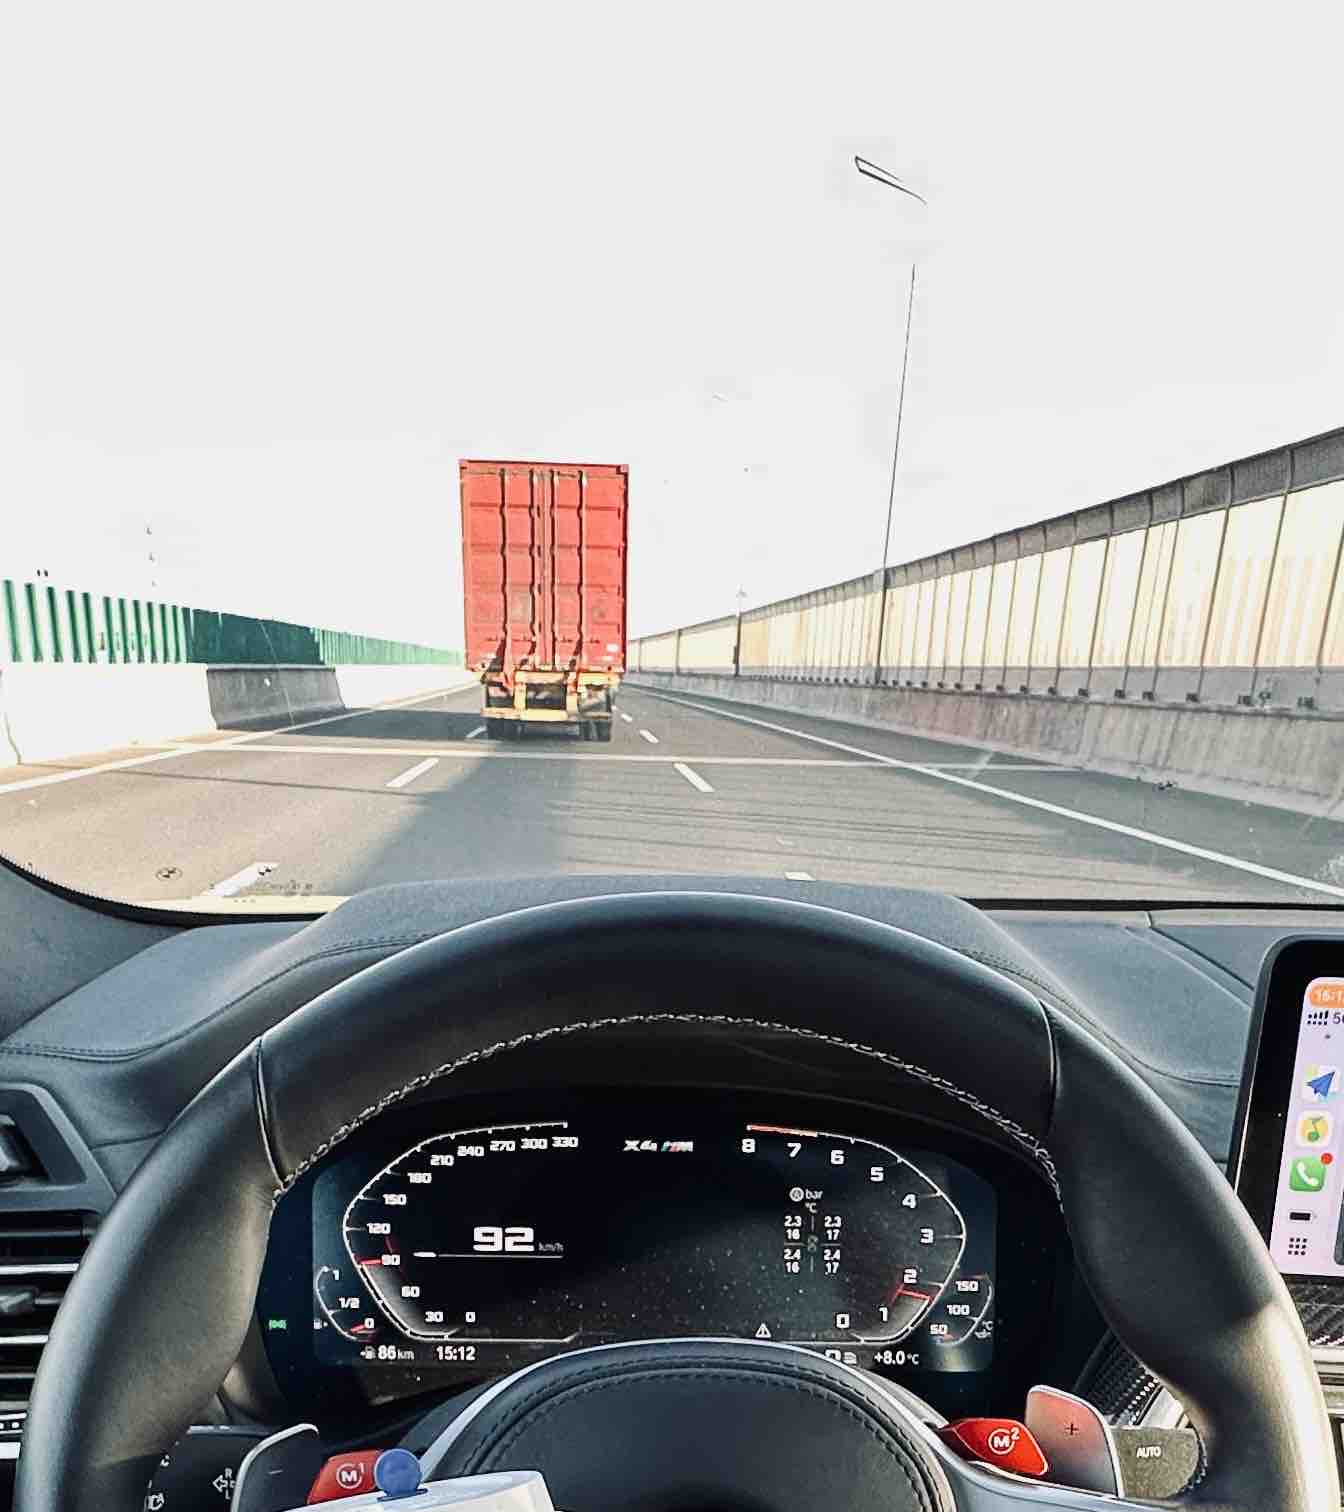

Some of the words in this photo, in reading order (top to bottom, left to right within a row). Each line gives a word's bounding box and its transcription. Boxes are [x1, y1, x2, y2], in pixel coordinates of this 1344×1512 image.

[490, 1140, 516, 1152] 270
[520, 1138, 548, 1150] 300
[552, 1136, 579, 1148] 330
[741, 1138, 756, 1153] 8
[457, 1145, 485, 1157] 240
[787, 1143, 802, 1158] 7
[430, 1155, 455, 1166] 210
[830, 1149, 845, 1165] 6
[870, 1167, 885, 1182] 5
[382, 1193, 407, 1206] 150
[805, 1188, 823, 1200] bar
[902, 1194, 917, 1209] 4
[784, 1215, 802, 1228] 2.3
[824, 1215, 842, 1228] 2.3
[366, 1222, 391, 1234] 120
[473, 1226, 535, 1252] 92
[538, 1241, 564, 1253] km/h
[826, 1228, 840, 1241] 17
[920, 1229, 935, 1244] 3
[784, 1248, 801, 1260] 2.4
[823, 1249, 841, 1261] 2.4
[903, 1268, 918, 1284] 2
[955, 1280, 979, 1292] 150
[338, 1297, 360, 1309] 1/2
[878, 1306, 889, 1322] 1
[946, 1304, 970, 1316] 100
[364, 1317, 375, 1329] 0
[424, 1311, 444, 1323] 30
[465, 1311, 476, 1323] 0
[835, 1313, 850, 1329] 0
[930, 1323, 949, 1335] 50
[377, 1346, 397, 1360] 86
[397, 1348, 415, 1360] km
[436, 1346, 476, 1361] 15:12
[873, 1350, 906, 1365] +8.0
[1136, 1446, 1161, 1458] AUTO
